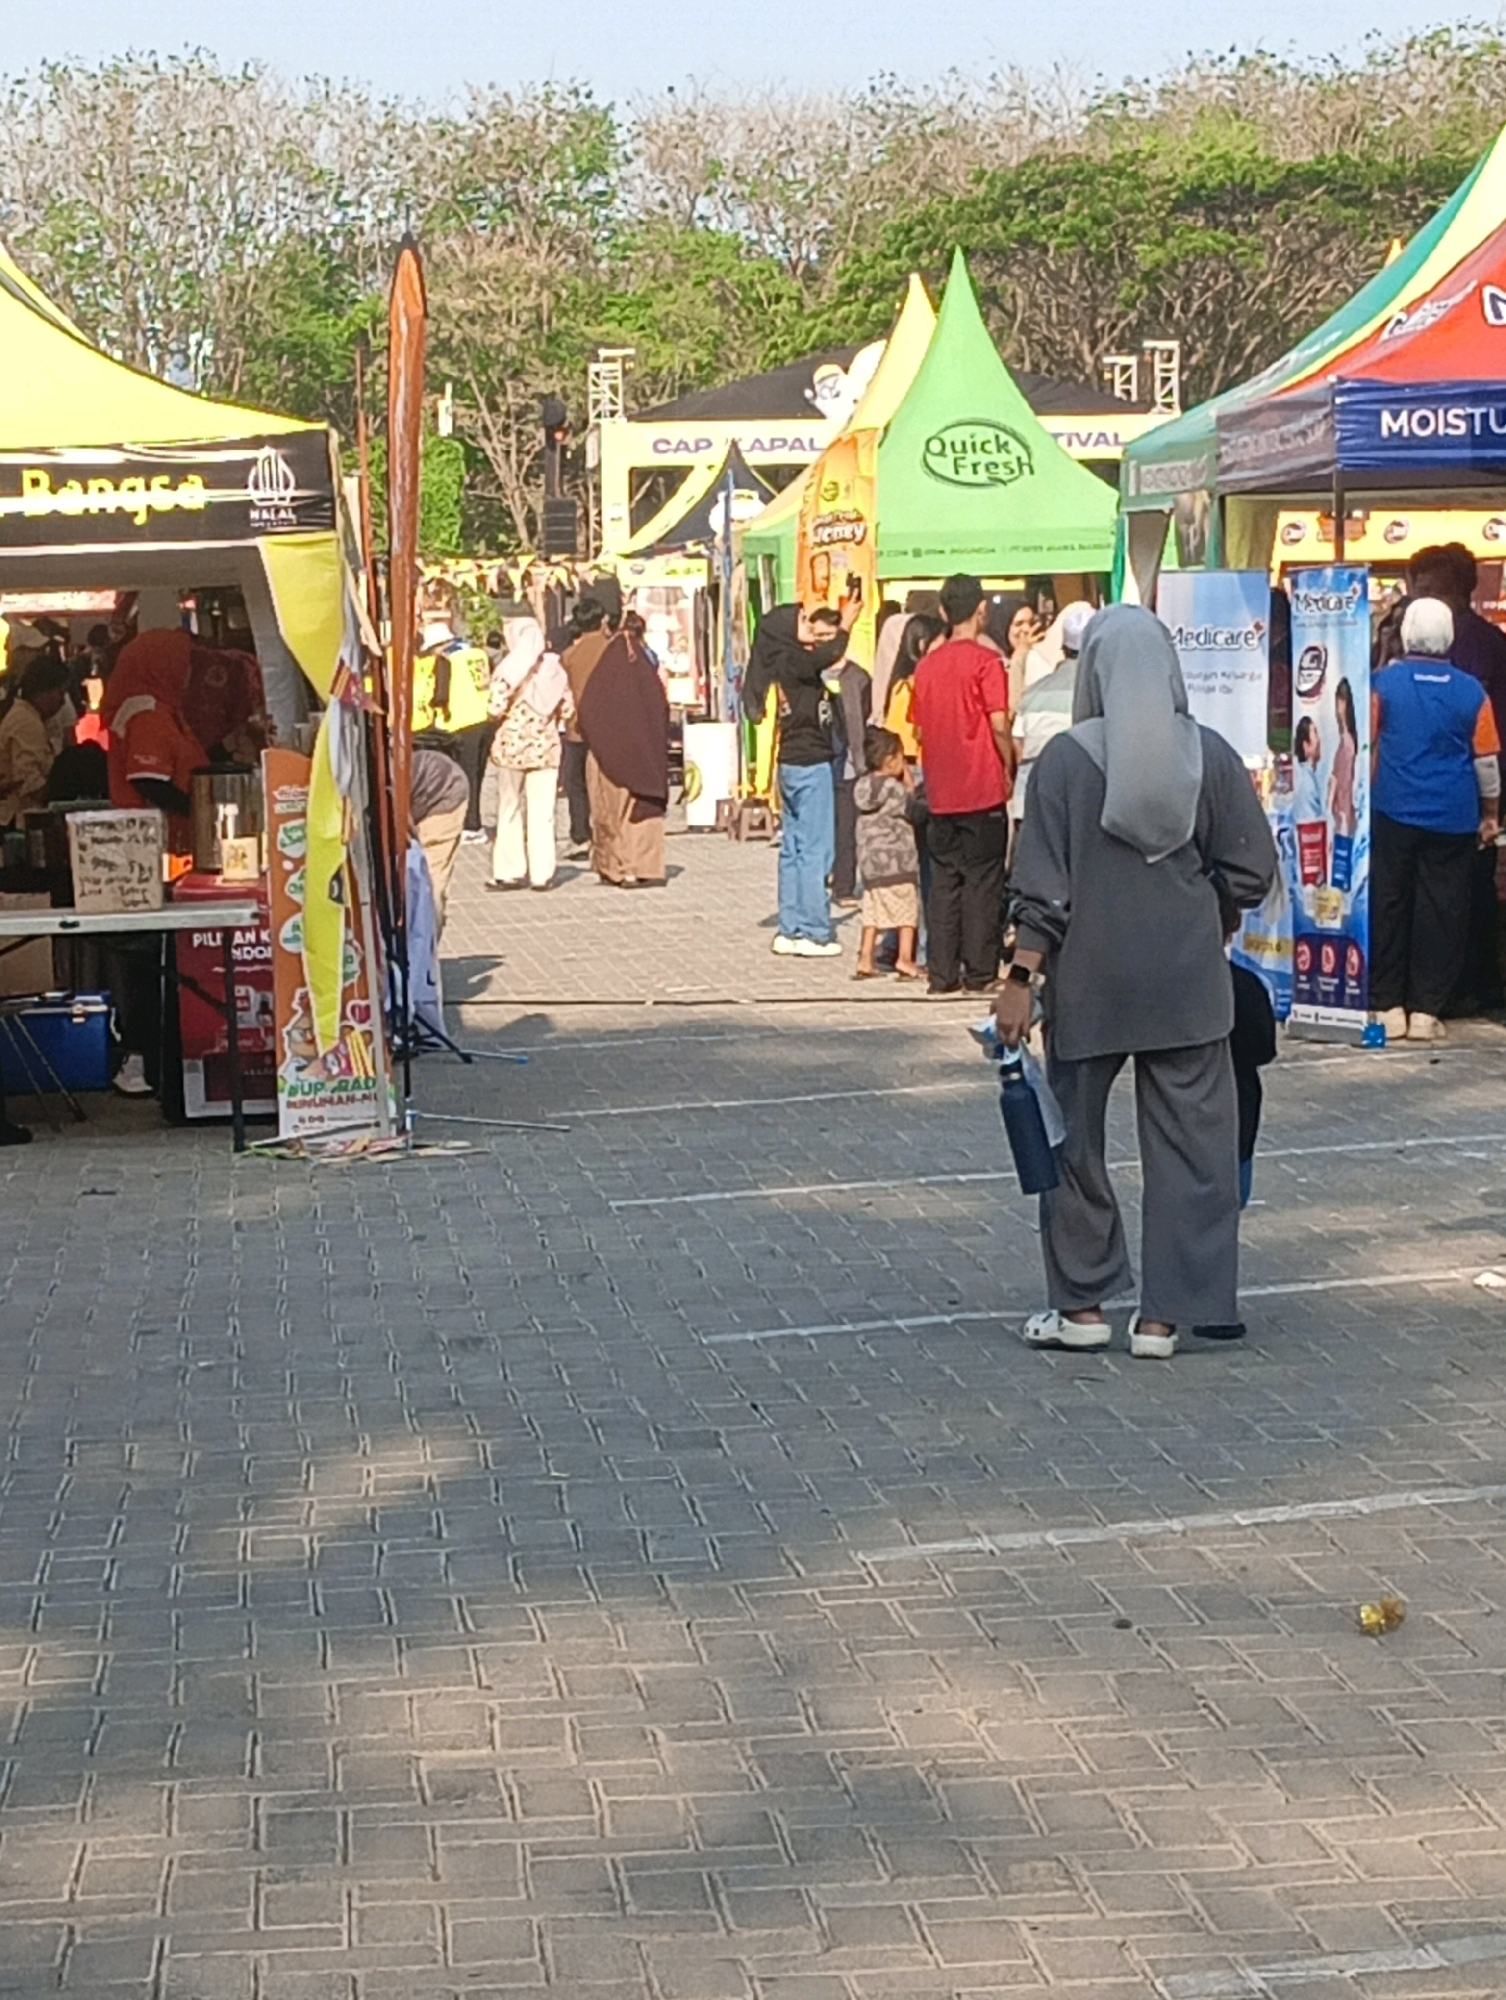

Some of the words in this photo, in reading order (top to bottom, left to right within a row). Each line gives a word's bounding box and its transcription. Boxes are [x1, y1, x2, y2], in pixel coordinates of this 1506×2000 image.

[1381, 407, 1506, 438] MOISTU
[652, 438, 713, 454] CAP
[724, 437, 828, 453] APAL
[925, 433, 1012, 458] Quick
[953, 455, 1035, 476] Fresh
[22, 469, 205, 525] Bangsa
[193, 929, 256, 947] PILIAN
